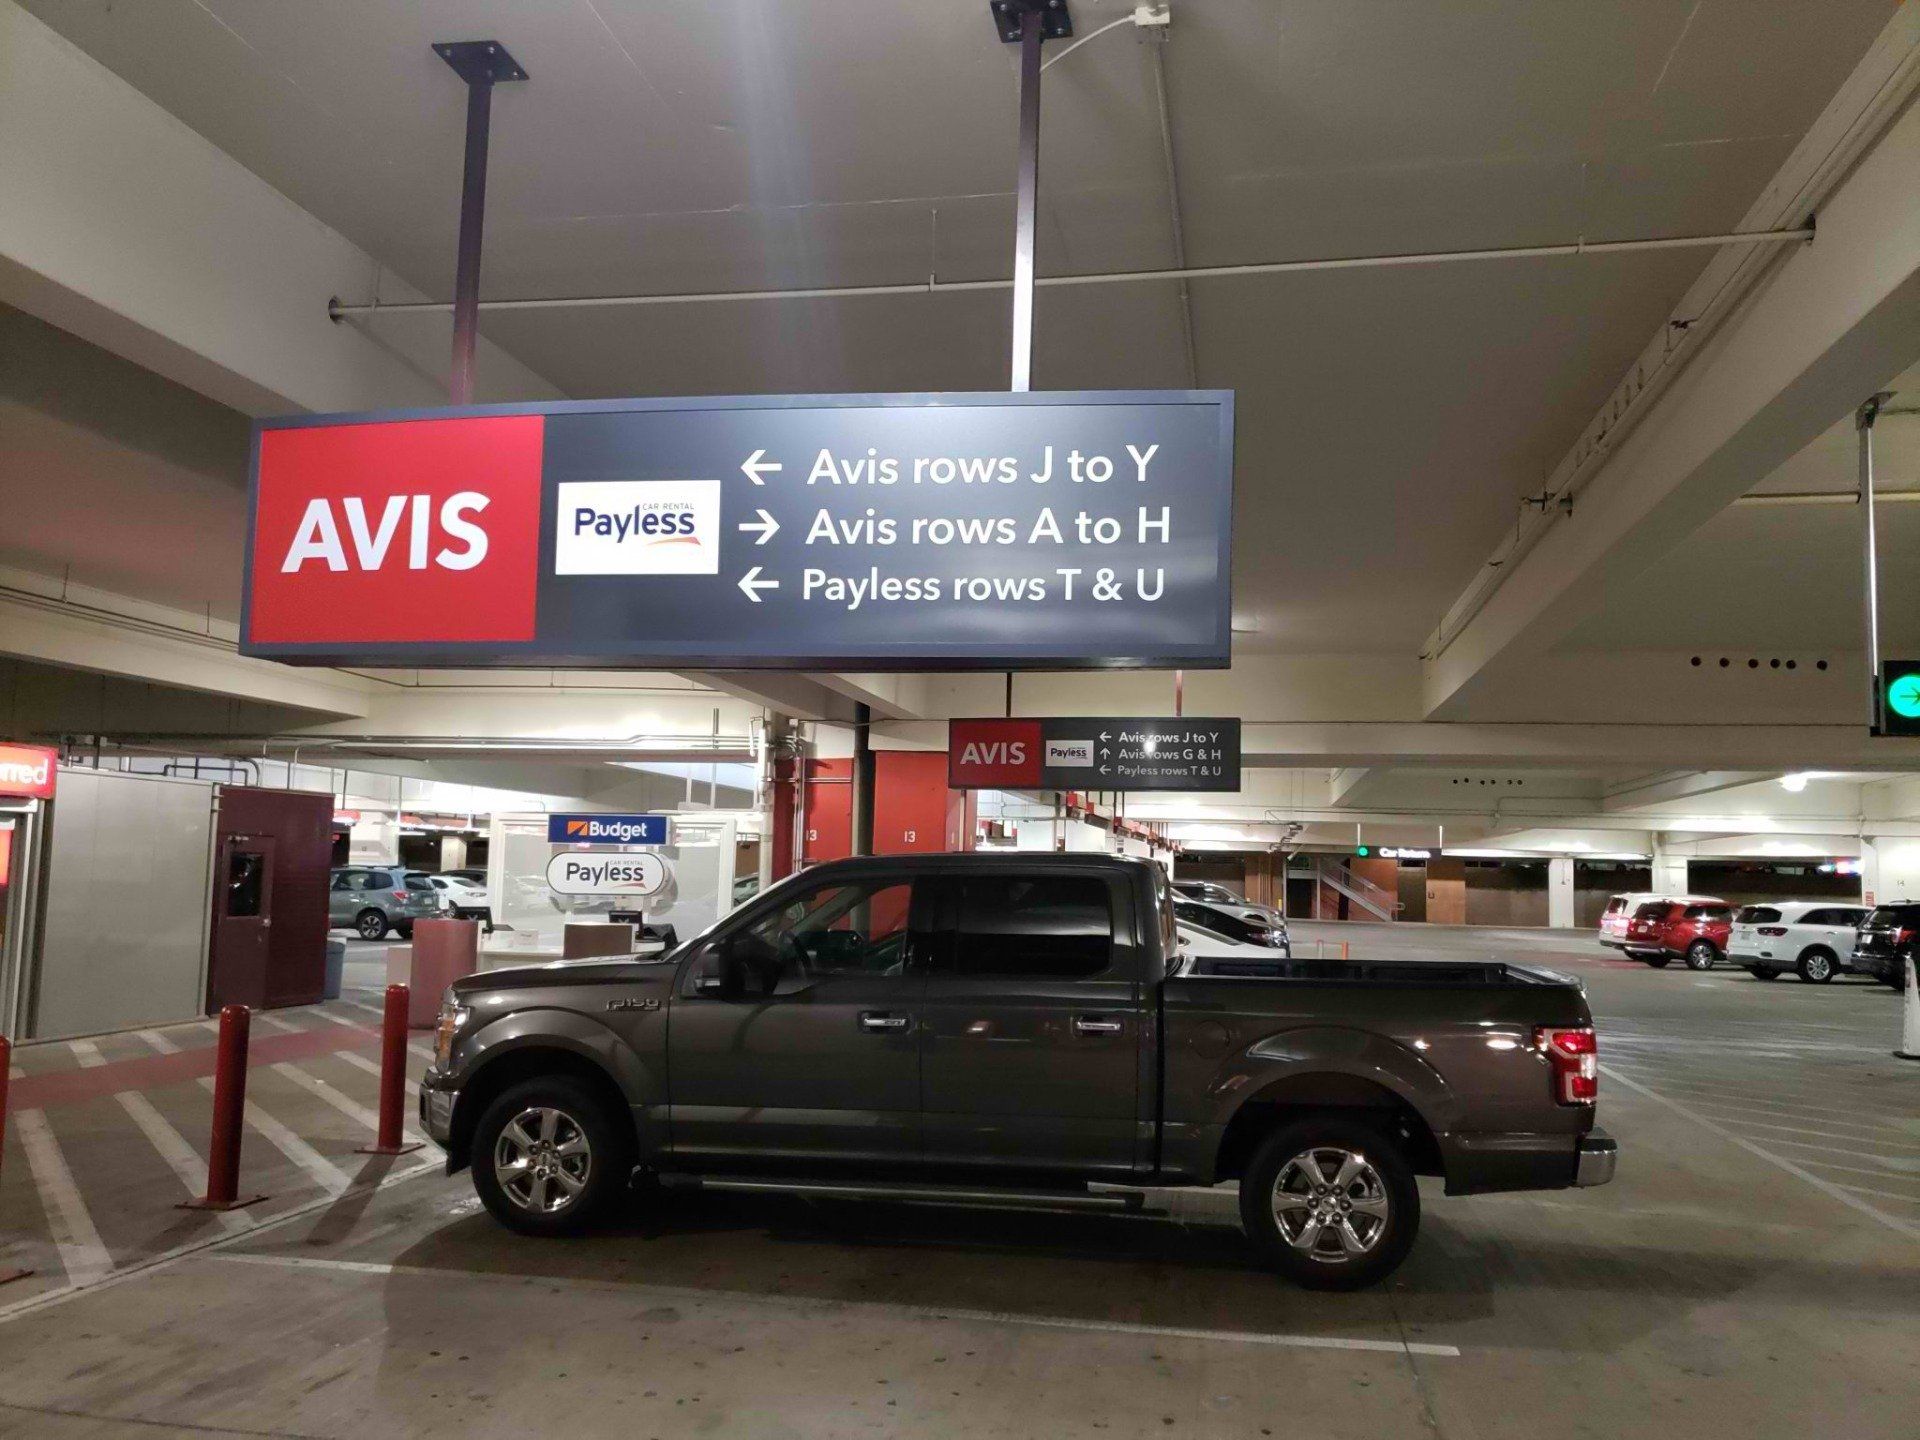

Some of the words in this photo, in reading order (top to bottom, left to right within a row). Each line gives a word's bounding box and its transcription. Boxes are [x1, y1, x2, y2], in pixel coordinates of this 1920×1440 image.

[807, 447, 899, 485] Avis
[913, 456, 1018, 484] rows
[1030, 445, 1053, 484] J
[1067, 449, 1114, 483] to
[1126, 444, 1159, 482] Y
[642, 503, 660, 511] CAR
[663, 502, 695, 511] RENTAL
[281, 491, 491, 573] AVIS
[575, 504, 695, 544] Payless
[805, 508, 898, 545] Avis
[912, 516, 1016, 545] rows
[1028, 507, 1063, 544] A
[1075, 511, 1121, 544] to
[1138, 506, 1171, 543] H
[803, 567, 941, 610] Payless
[954, 576, 1046, 601] rows
[1056, 568, 1082, 600] T
[1092, 568, 1123, 601] &
[1137, 568, 1165, 601] U
[1118, 731, 1145, 743] Avis
[1147, 734, 1180, 743] rows
[1182, 731, 1190, 743] J
[1193, 733, 1206, 743] to
[1209, 731, 1219, 743] Y
[960, 742, 1026, 765] AVIS
[1050, 747, 1087, 759] Payless
[1118, 748, 1145, 760] Avis
[1182, 748, 1193, 760] G
[1197, 748, 1207, 760] &
[1211, 748, 1222, 760] H
[1117, 764, 1158, 777] Payless
[1190, 765, 1198, 775] T
[1200, 765, 1209, 776] &
[1212, 766, 1222, 776] U
[589, 821, 648, 841] Budget
[904, 830, 916, 843] 13
[566, 861, 644, 887] Payless
